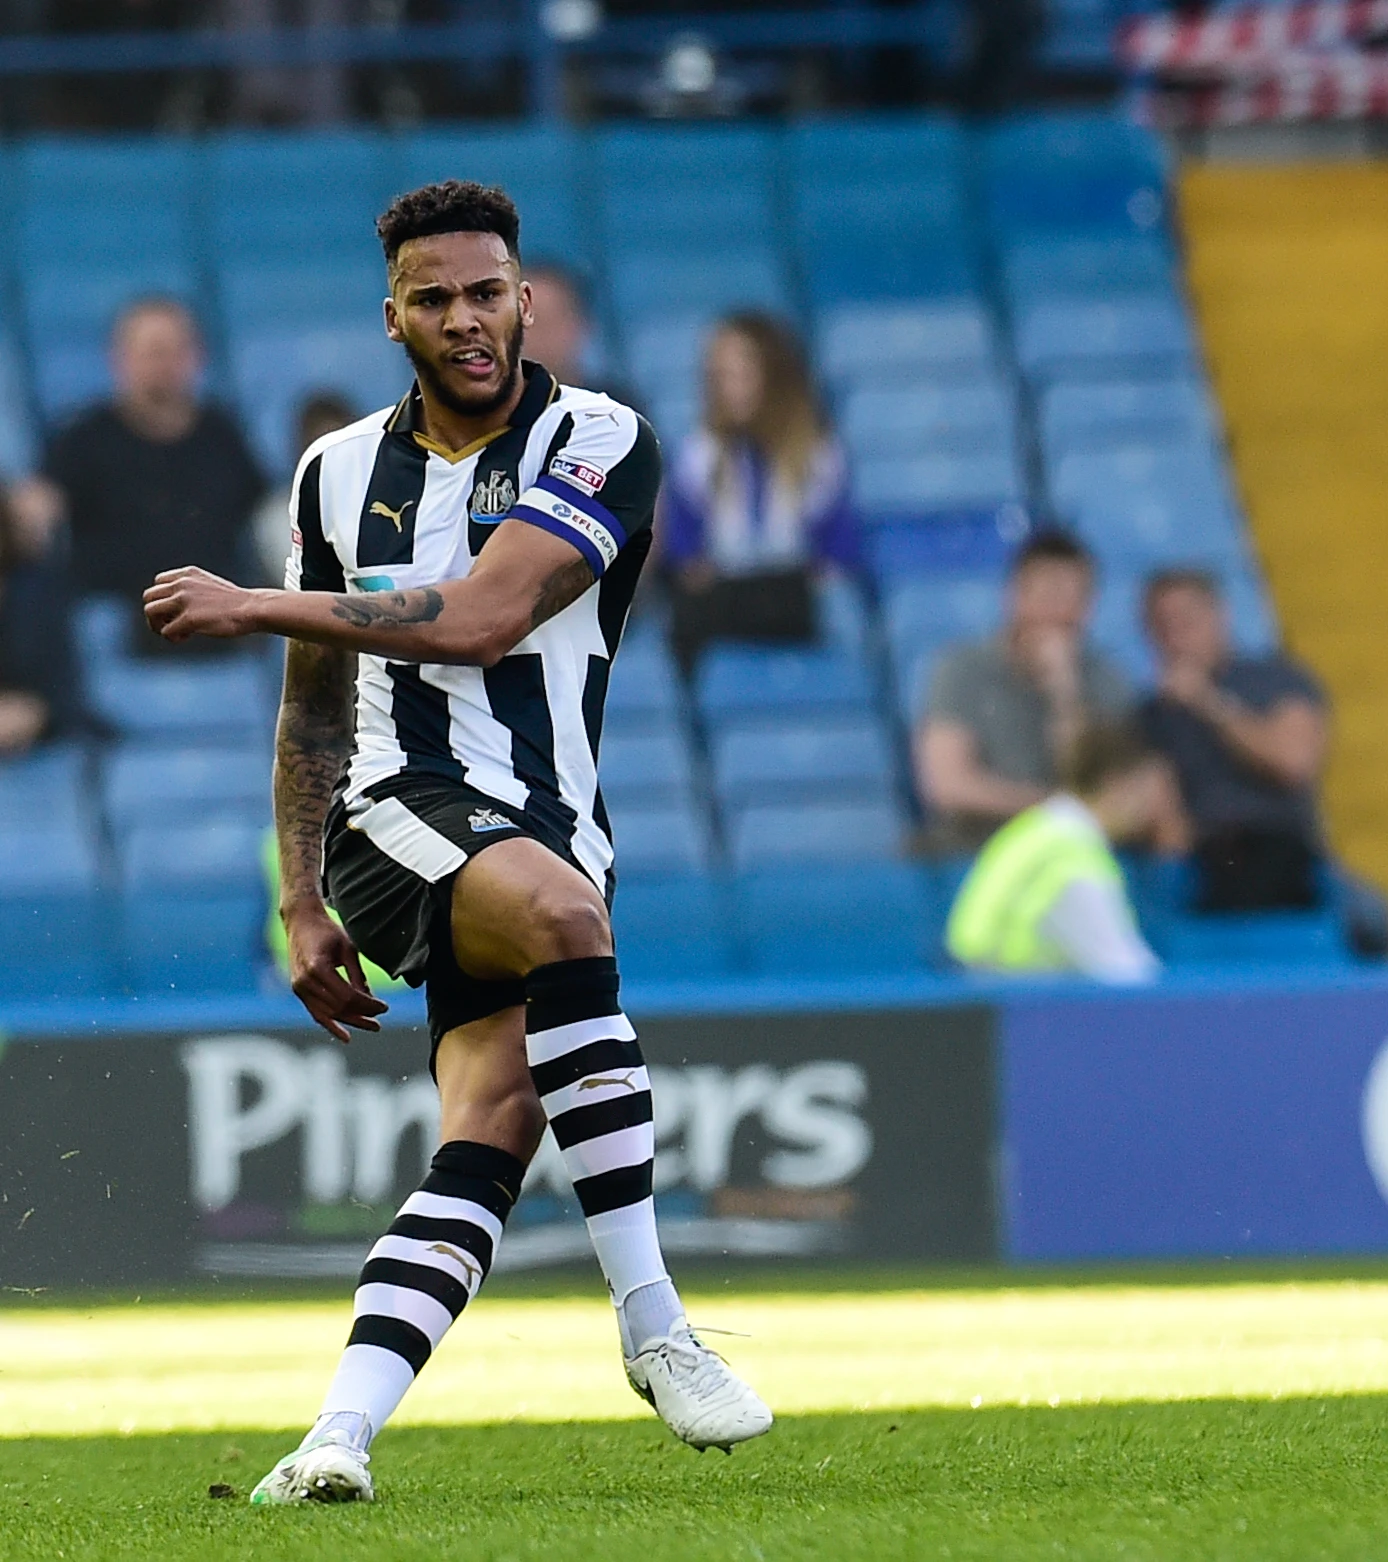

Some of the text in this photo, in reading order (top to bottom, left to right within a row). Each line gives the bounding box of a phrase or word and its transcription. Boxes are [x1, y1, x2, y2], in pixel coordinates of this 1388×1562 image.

[576, 466, 602, 486] BET
[571, 513, 592, 532] EFL
[183, 1035, 872, 1210] Piners
